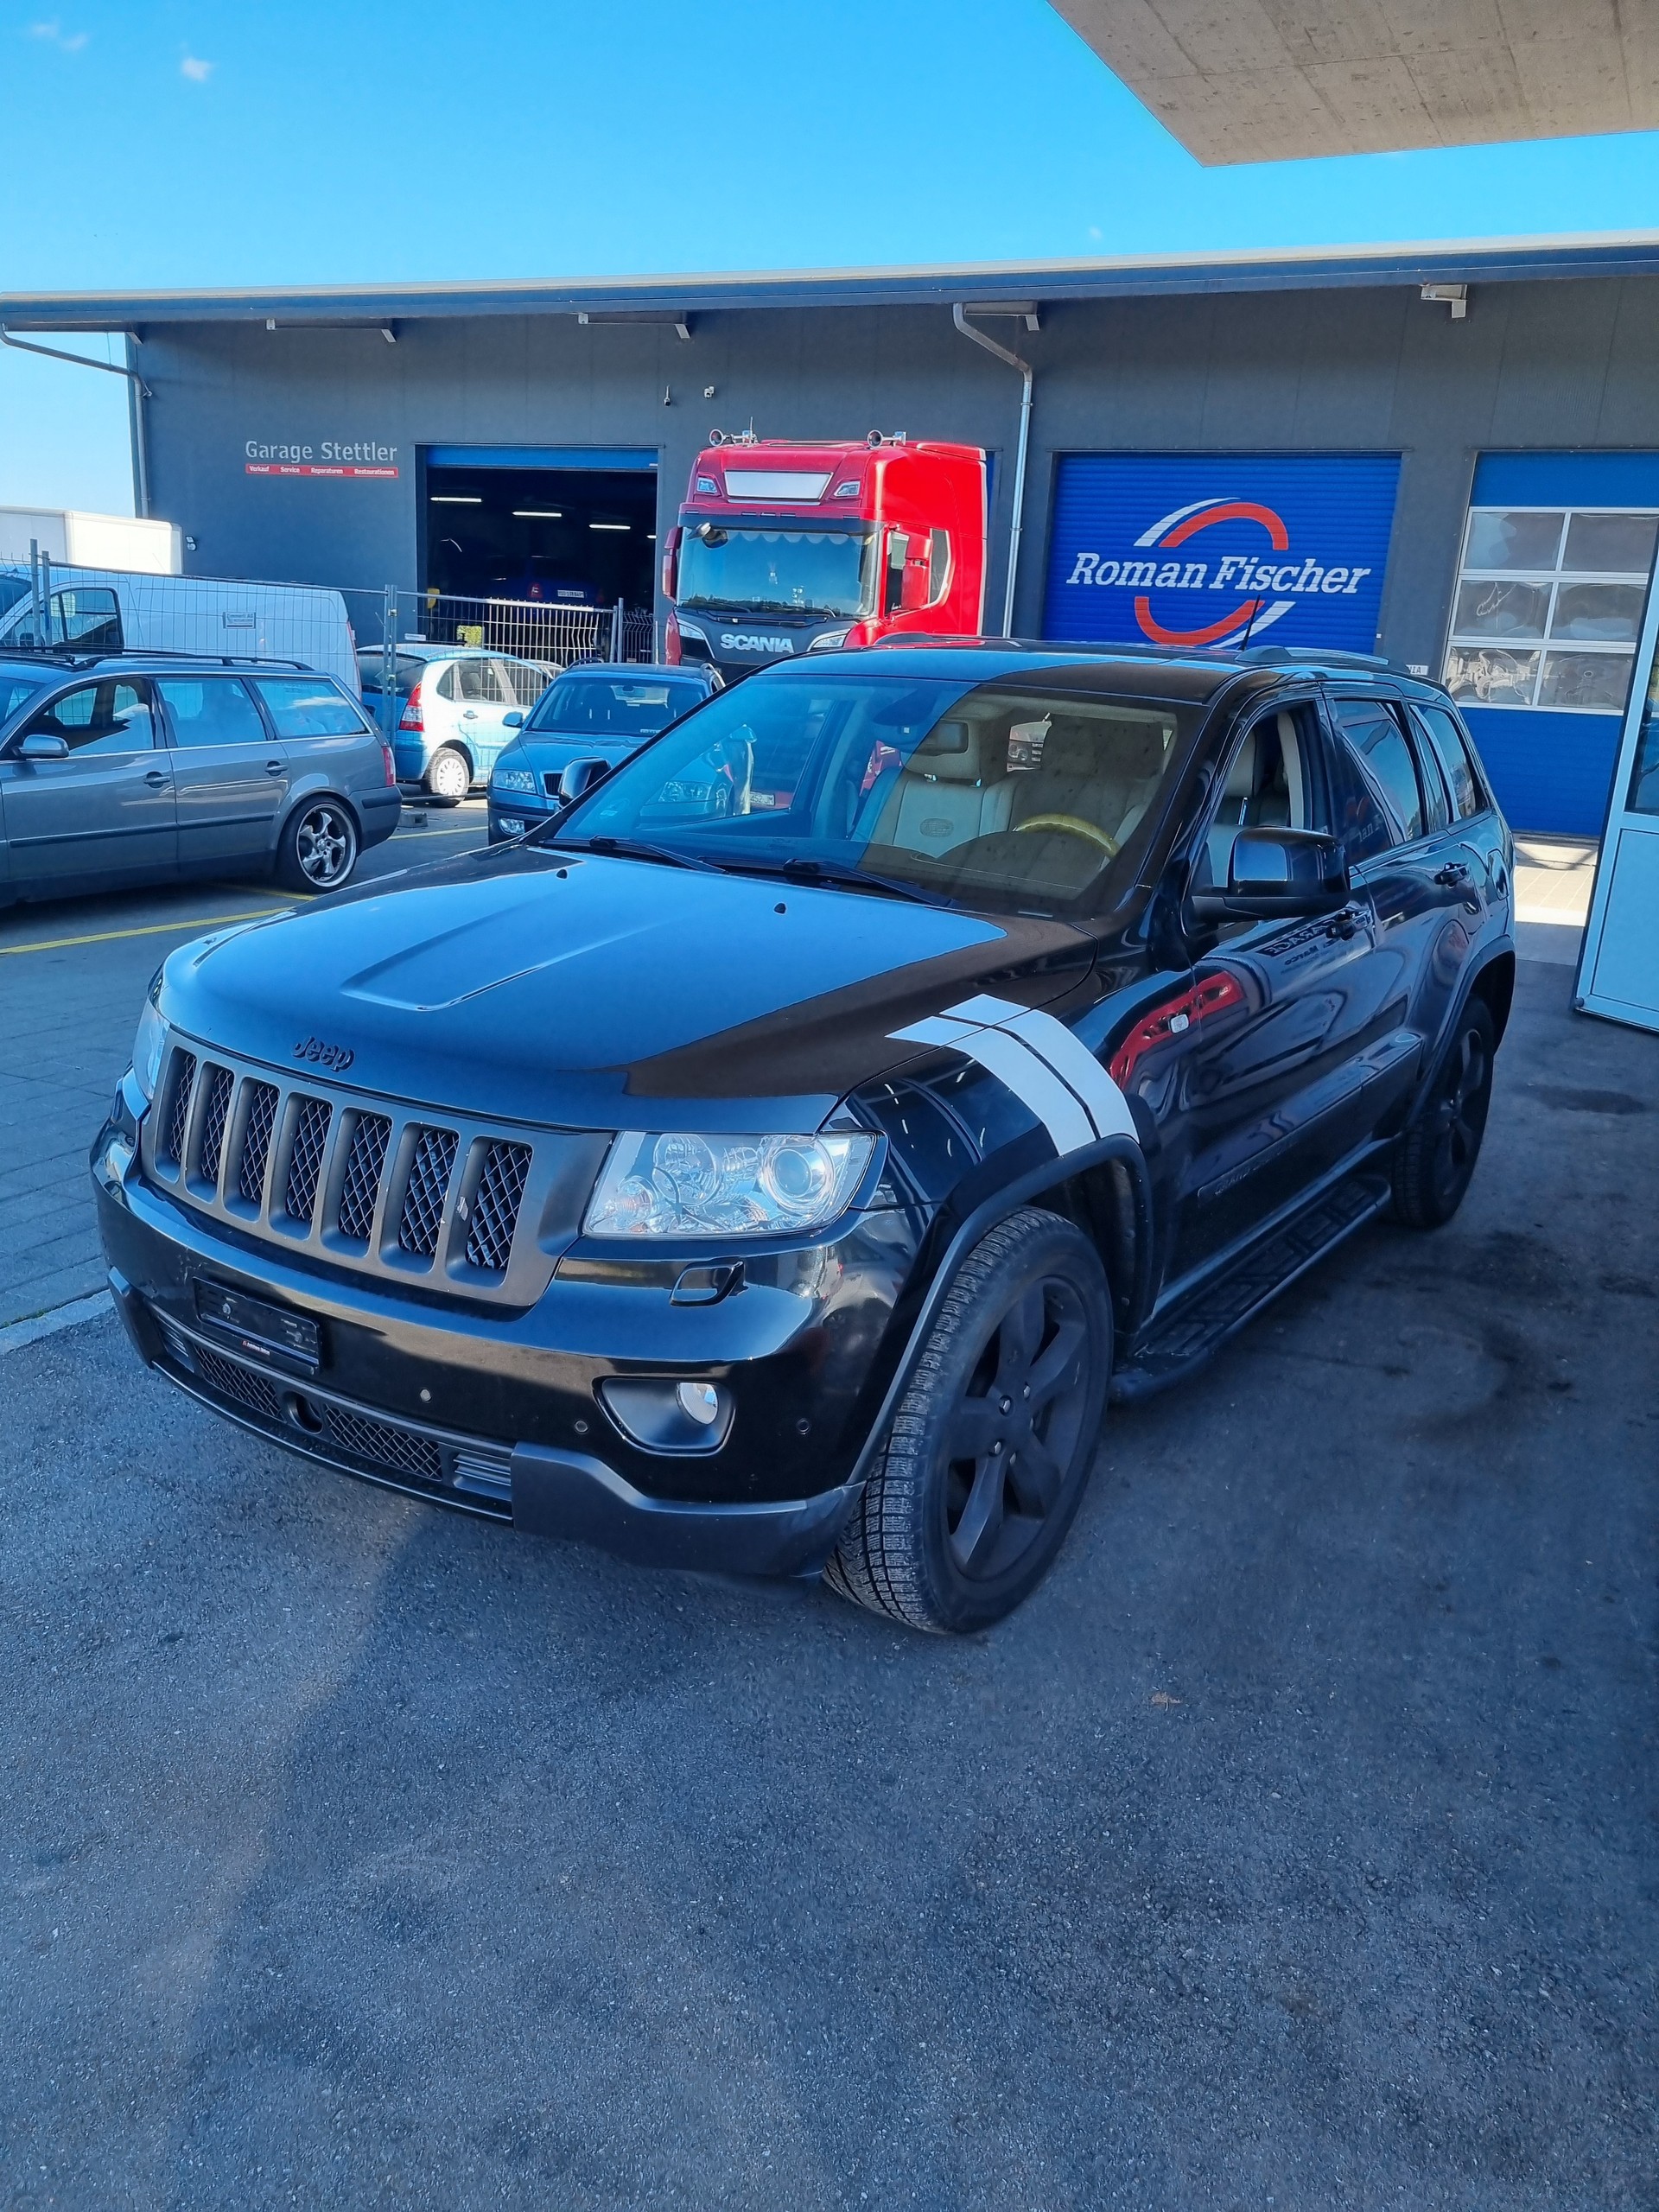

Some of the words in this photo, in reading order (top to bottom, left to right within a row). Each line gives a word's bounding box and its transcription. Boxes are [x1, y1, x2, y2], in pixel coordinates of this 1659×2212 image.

[245, 441, 313, 463] Garage
[321, 442, 397, 461] Stettler
[1065, 552, 1208, 589] Roman
[1209, 556, 1372, 594] Fischer
[720, 633, 795, 653] SCANIA
[290, 1036, 355, 1073] Jeep
